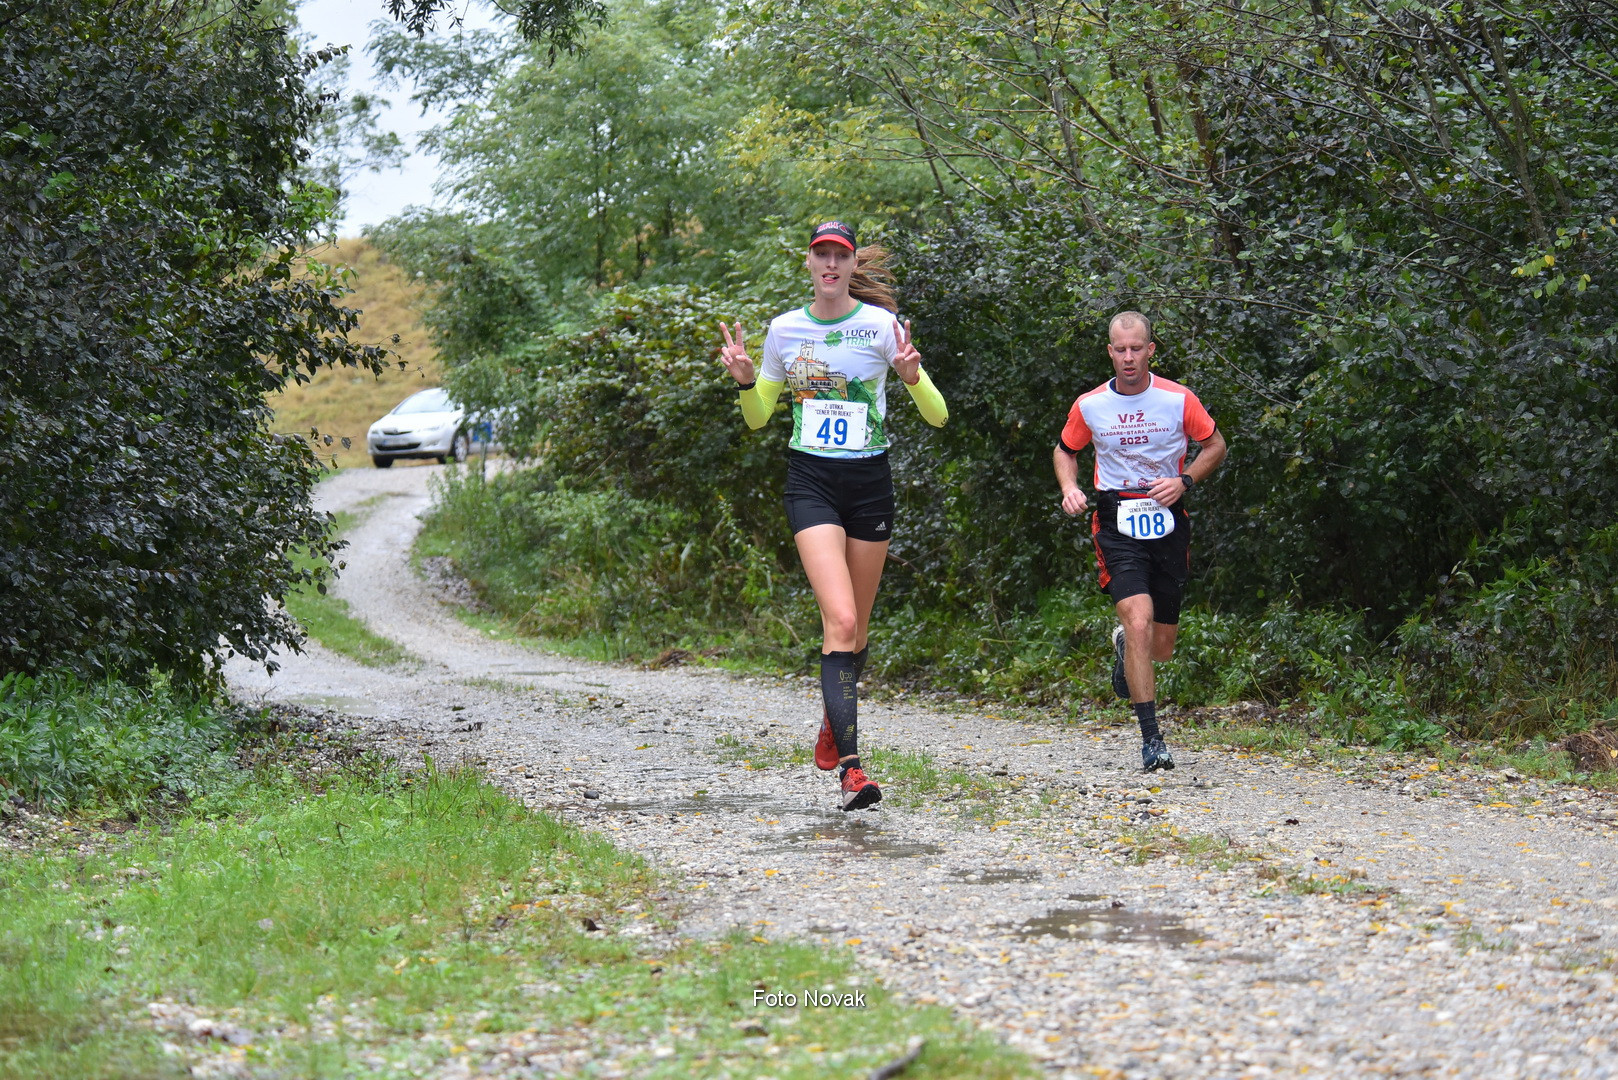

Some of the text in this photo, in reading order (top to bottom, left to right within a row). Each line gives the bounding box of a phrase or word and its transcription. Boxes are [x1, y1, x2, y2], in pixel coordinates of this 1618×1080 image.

[845, 337, 873, 347] TRAIL
[816, 418, 848, 445] 49
[1119, 435, 1149, 445] 2023
[1126, 512, 1165, 538] 108
